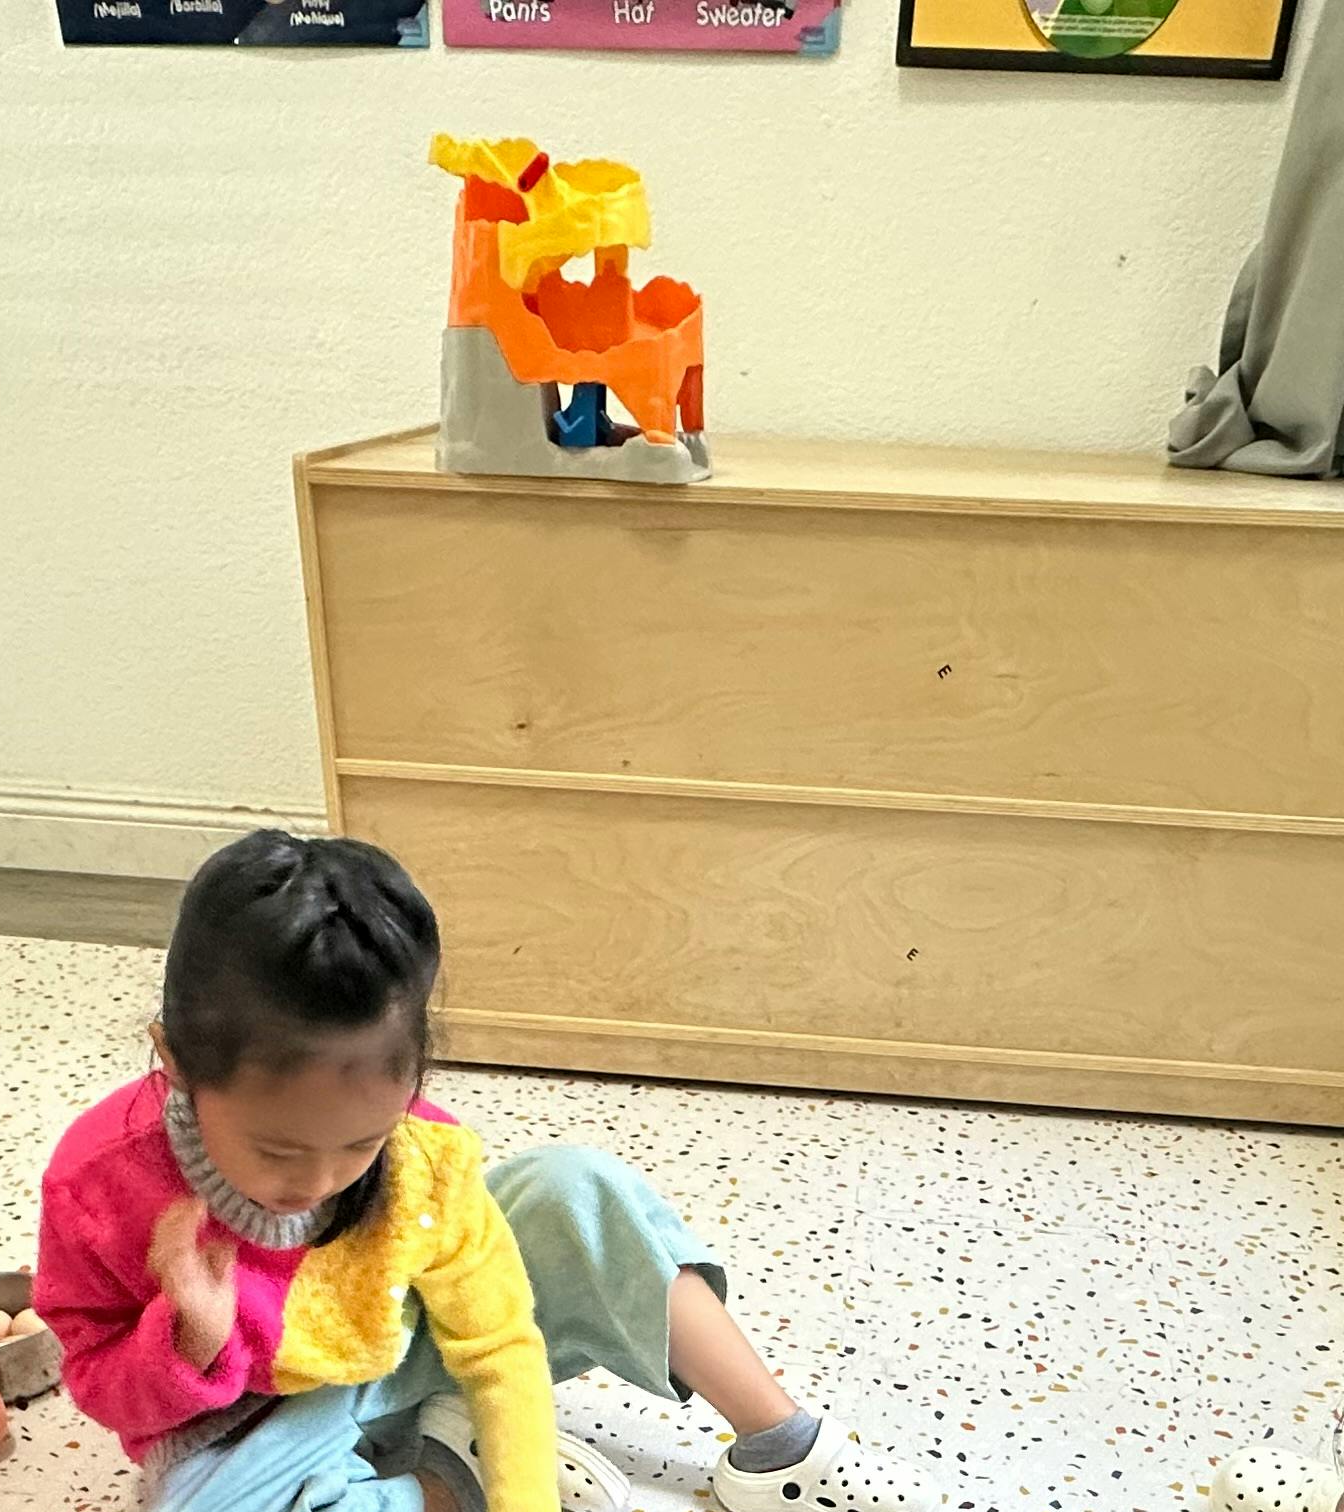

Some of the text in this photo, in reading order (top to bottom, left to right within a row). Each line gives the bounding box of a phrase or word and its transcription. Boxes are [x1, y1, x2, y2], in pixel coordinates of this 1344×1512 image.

[489, 0, 551, 23] Pants
[613, 1, 654, 24] Hat
[696, 4, 786, 28] Sweater
